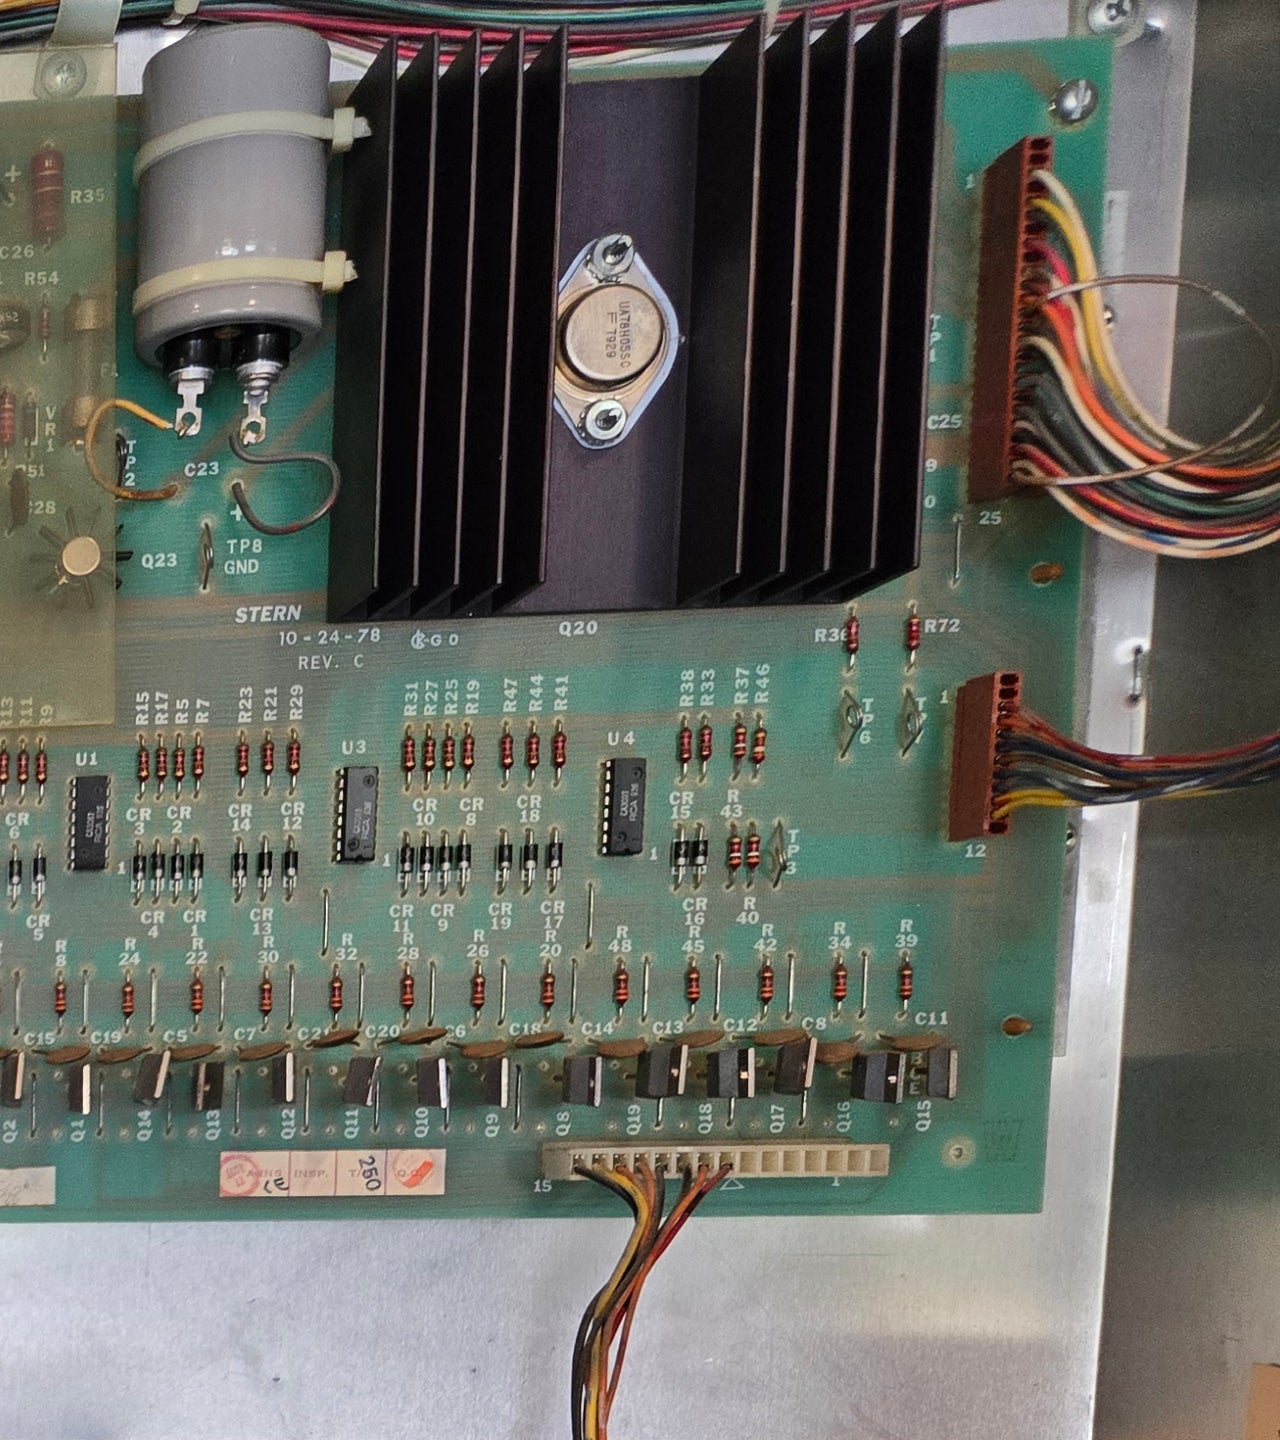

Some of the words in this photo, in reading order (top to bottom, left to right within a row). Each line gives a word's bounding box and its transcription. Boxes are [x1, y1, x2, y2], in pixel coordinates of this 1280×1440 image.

[70, 188, 105, 204] R35
[24, 270, 60, 286] R54
[183, 461, 220, 478] C23
[226, 538, 263, 555] TP8
[141, 552, 178, 570] Q23
[223, 558, 260, 575] GND
[234, 604, 302, 624] STERN
[558, 620, 598, 638] Q20
[298, 654, 339, 670] REV.
[353, 653, 364, 669] C
[607, 730, 636, 746] U4
[341, 739, 367, 756] U3
[75, 751, 98, 767] U1
[364, 1024, 401, 1039] C20
